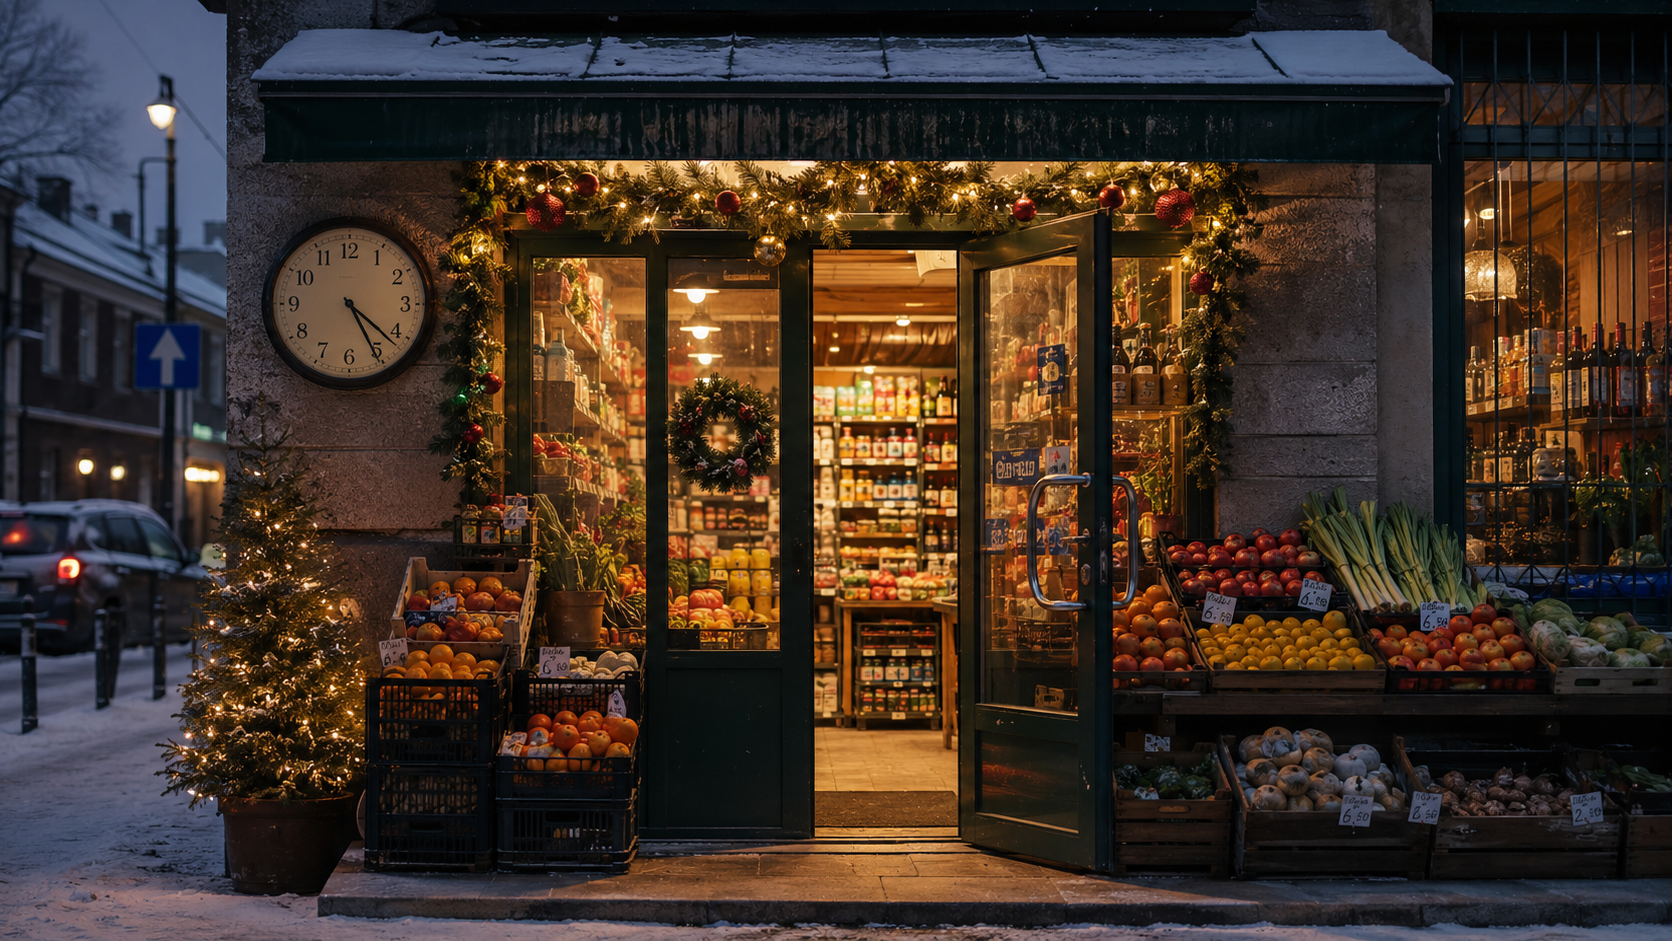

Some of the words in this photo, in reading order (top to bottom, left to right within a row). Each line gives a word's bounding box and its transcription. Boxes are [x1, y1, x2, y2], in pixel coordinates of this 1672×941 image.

[317, 249, 331, 266] 11
[341, 242, 359, 259] 12
[374, 249, 380, 266] 1
[296, 269, 314, 286] 10
[392, 269, 403, 285] 2
[288, 296, 300, 312] 9
[400, 296, 411, 312] 3
[296, 322, 308, 339] 8
[390, 322, 402, 339] 4
[317, 342, 329, 358] 7
[343, 349, 355, 365] 6
[371, 342, 382, 358] 5
